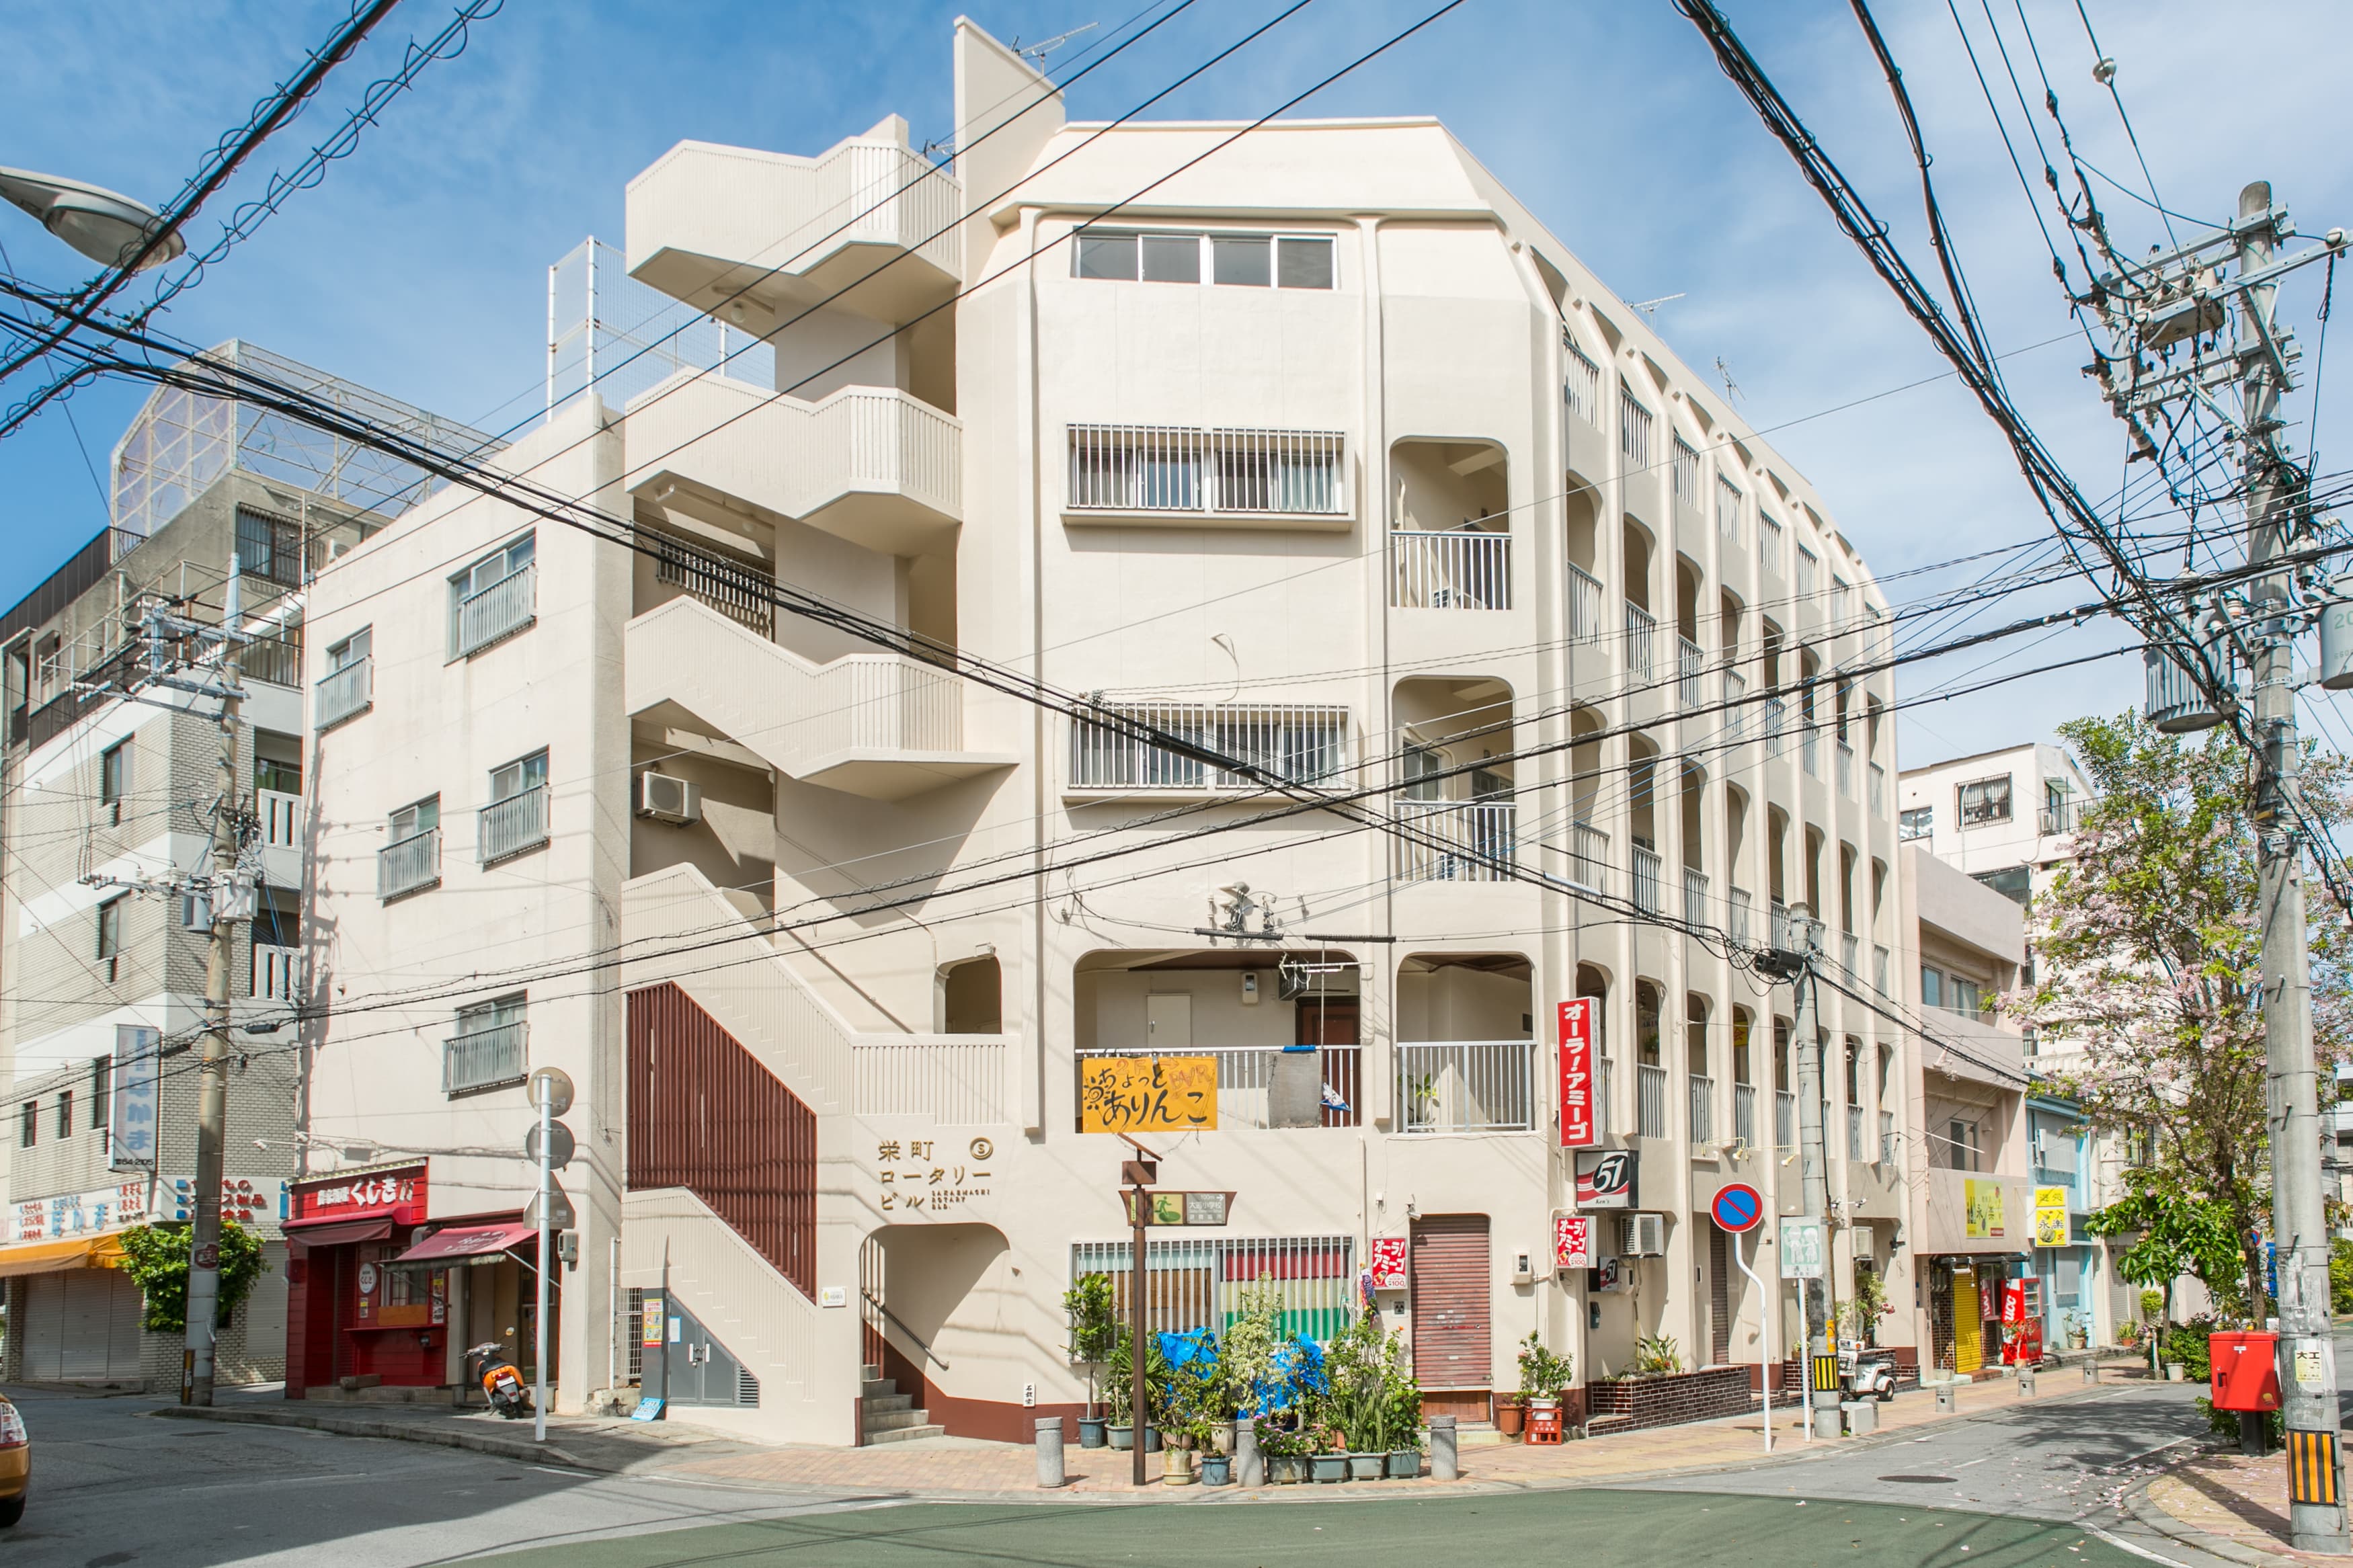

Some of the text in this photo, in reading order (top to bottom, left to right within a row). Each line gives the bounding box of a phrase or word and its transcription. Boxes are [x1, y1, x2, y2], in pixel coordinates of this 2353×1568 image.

[1099, 1064, 1168, 1089] ちょっと
[1564, 1003, 1588, 1140] オーラ!アミーゴ
[1103, 1089, 1207, 1127] ありんこ
[878, 1140, 934, 1162] 栄町
[879, 1165, 991, 1186] ロータリー
[1597, 1157, 1625, 1192] 51
[881, 1192, 925, 1210] ビル
[1559, 1219, 1586, 1236] オーラ!
[1374, 1239, 1405, 1257] オーラ!
[1558, 1233, 1587, 1251] アミーゴ
[1373, 1253, 1406, 1272] アミーゴ
[2004, 1294, 2016, 1321] UCC
[2297, 1352, 2319, 1360] 大工
